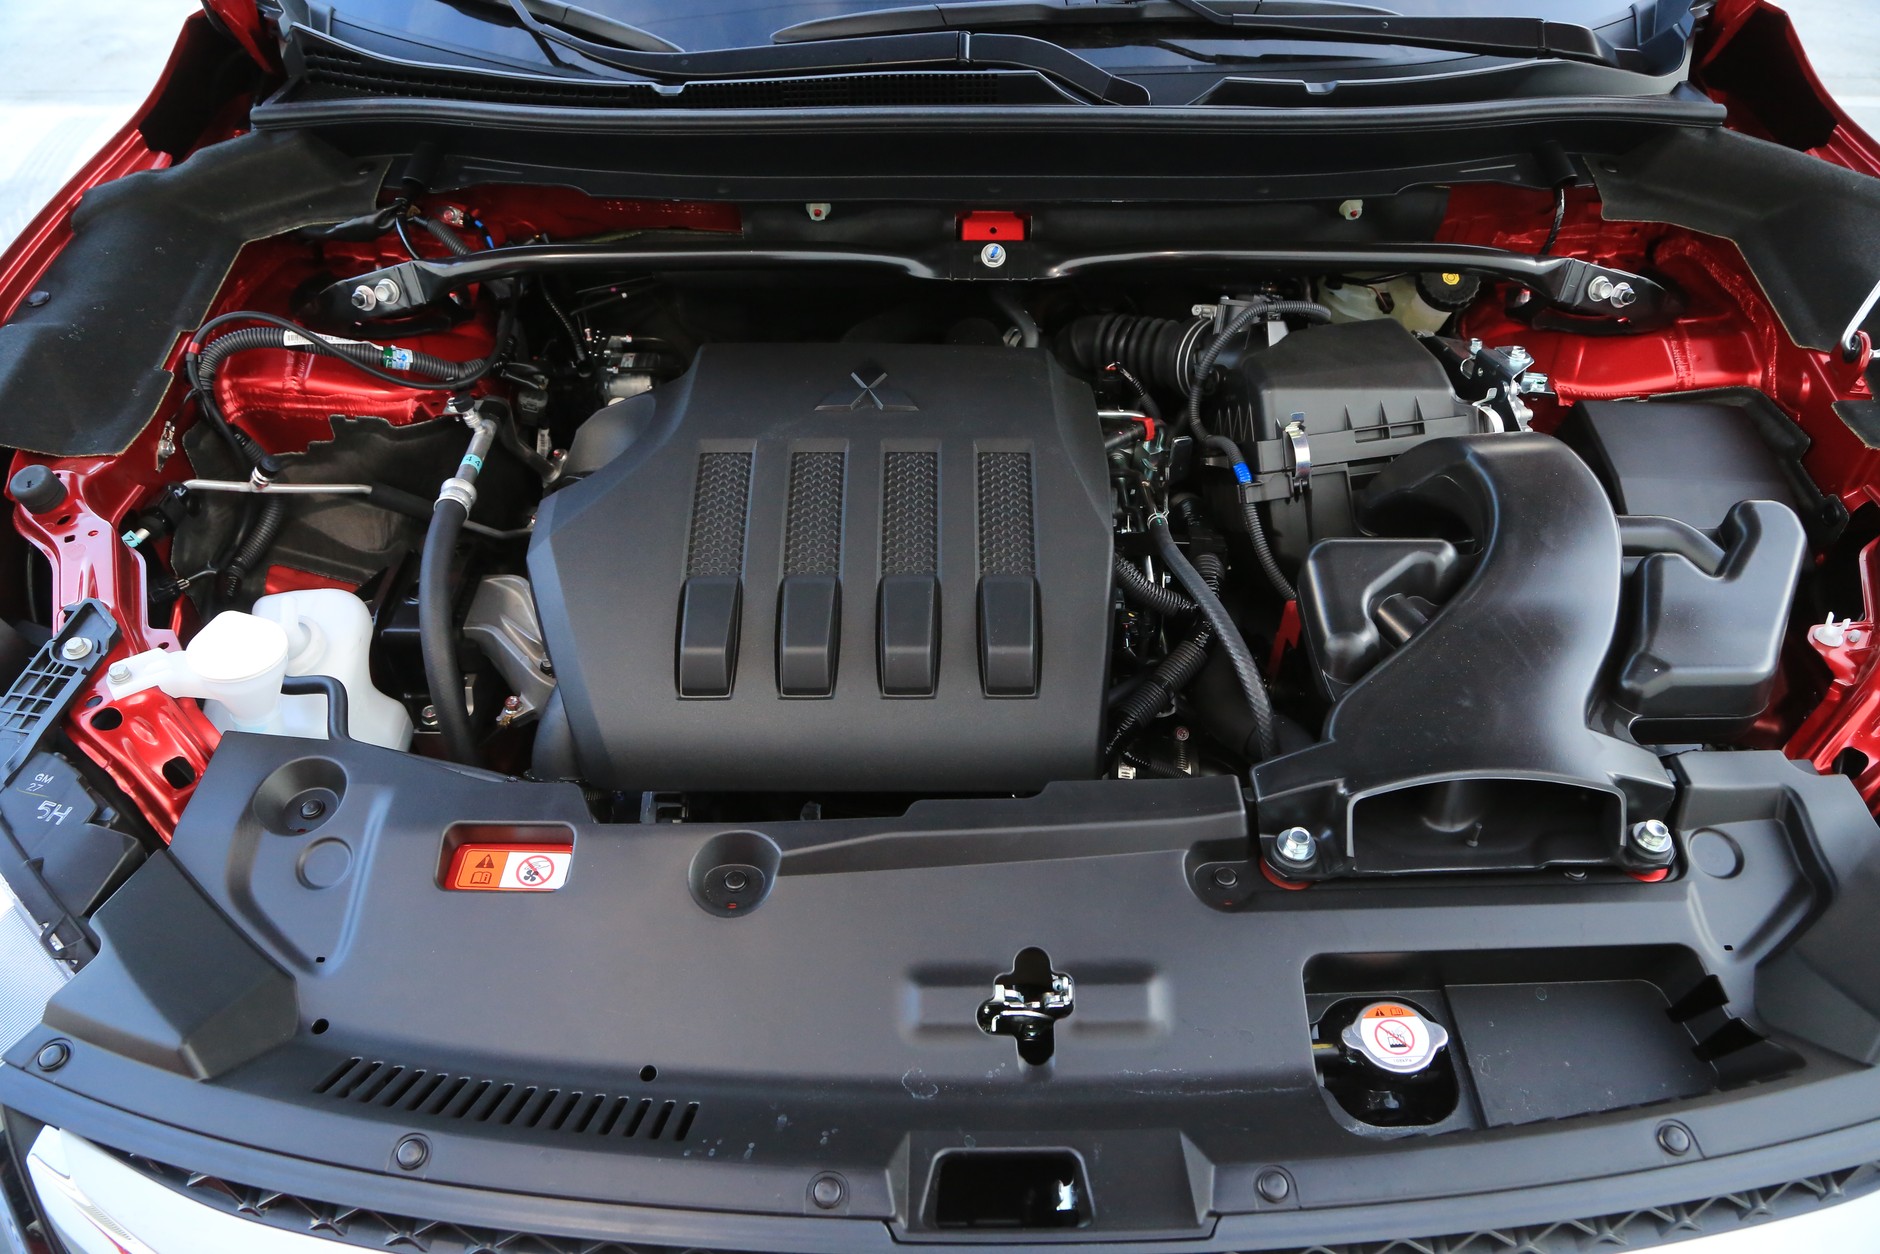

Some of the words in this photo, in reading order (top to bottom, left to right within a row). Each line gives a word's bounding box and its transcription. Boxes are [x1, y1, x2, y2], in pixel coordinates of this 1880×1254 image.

[34, 773, 55, 784] GM
[25, 782, 44, 792] 27
[36, 800, 73, 826] 5H
